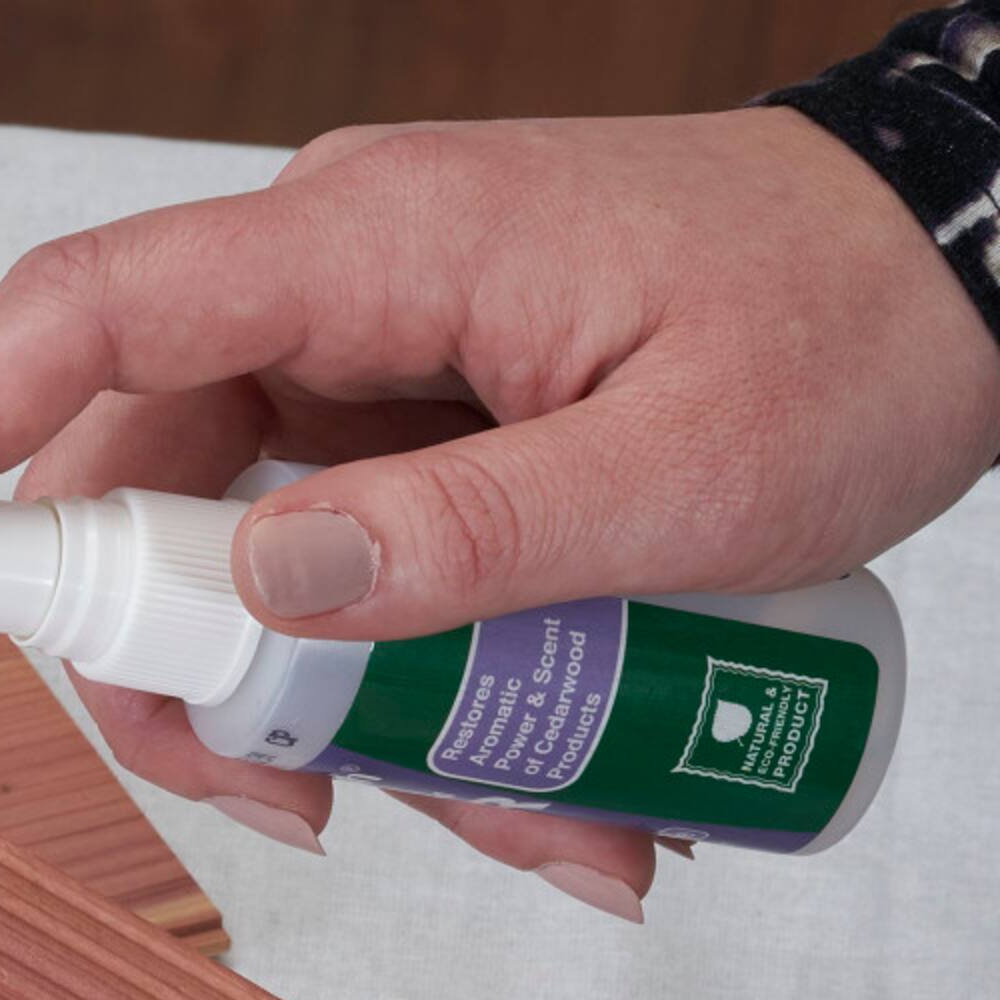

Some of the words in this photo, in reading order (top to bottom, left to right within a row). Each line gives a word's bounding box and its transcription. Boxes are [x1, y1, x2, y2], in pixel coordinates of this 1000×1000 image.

[533, 618, 561, 684] Scent
[534, 631, 586, 754] Cedarwood
[441, 674, 495, 760] Restores
[470, 678, 521, 766] Aromatic
[493, 714, 537, 770] Power
[526, 691, 547, 708] &
[546, 692, 601, 779] Products
[741, 702, 775, 772] NATURAL
[764, 687, 777, 698] &
[757, 684, 793, 775] ECO-FRIENDLY
[772, 688, 810, 778] PRODUCT
[525, 758, 545, 775] of
